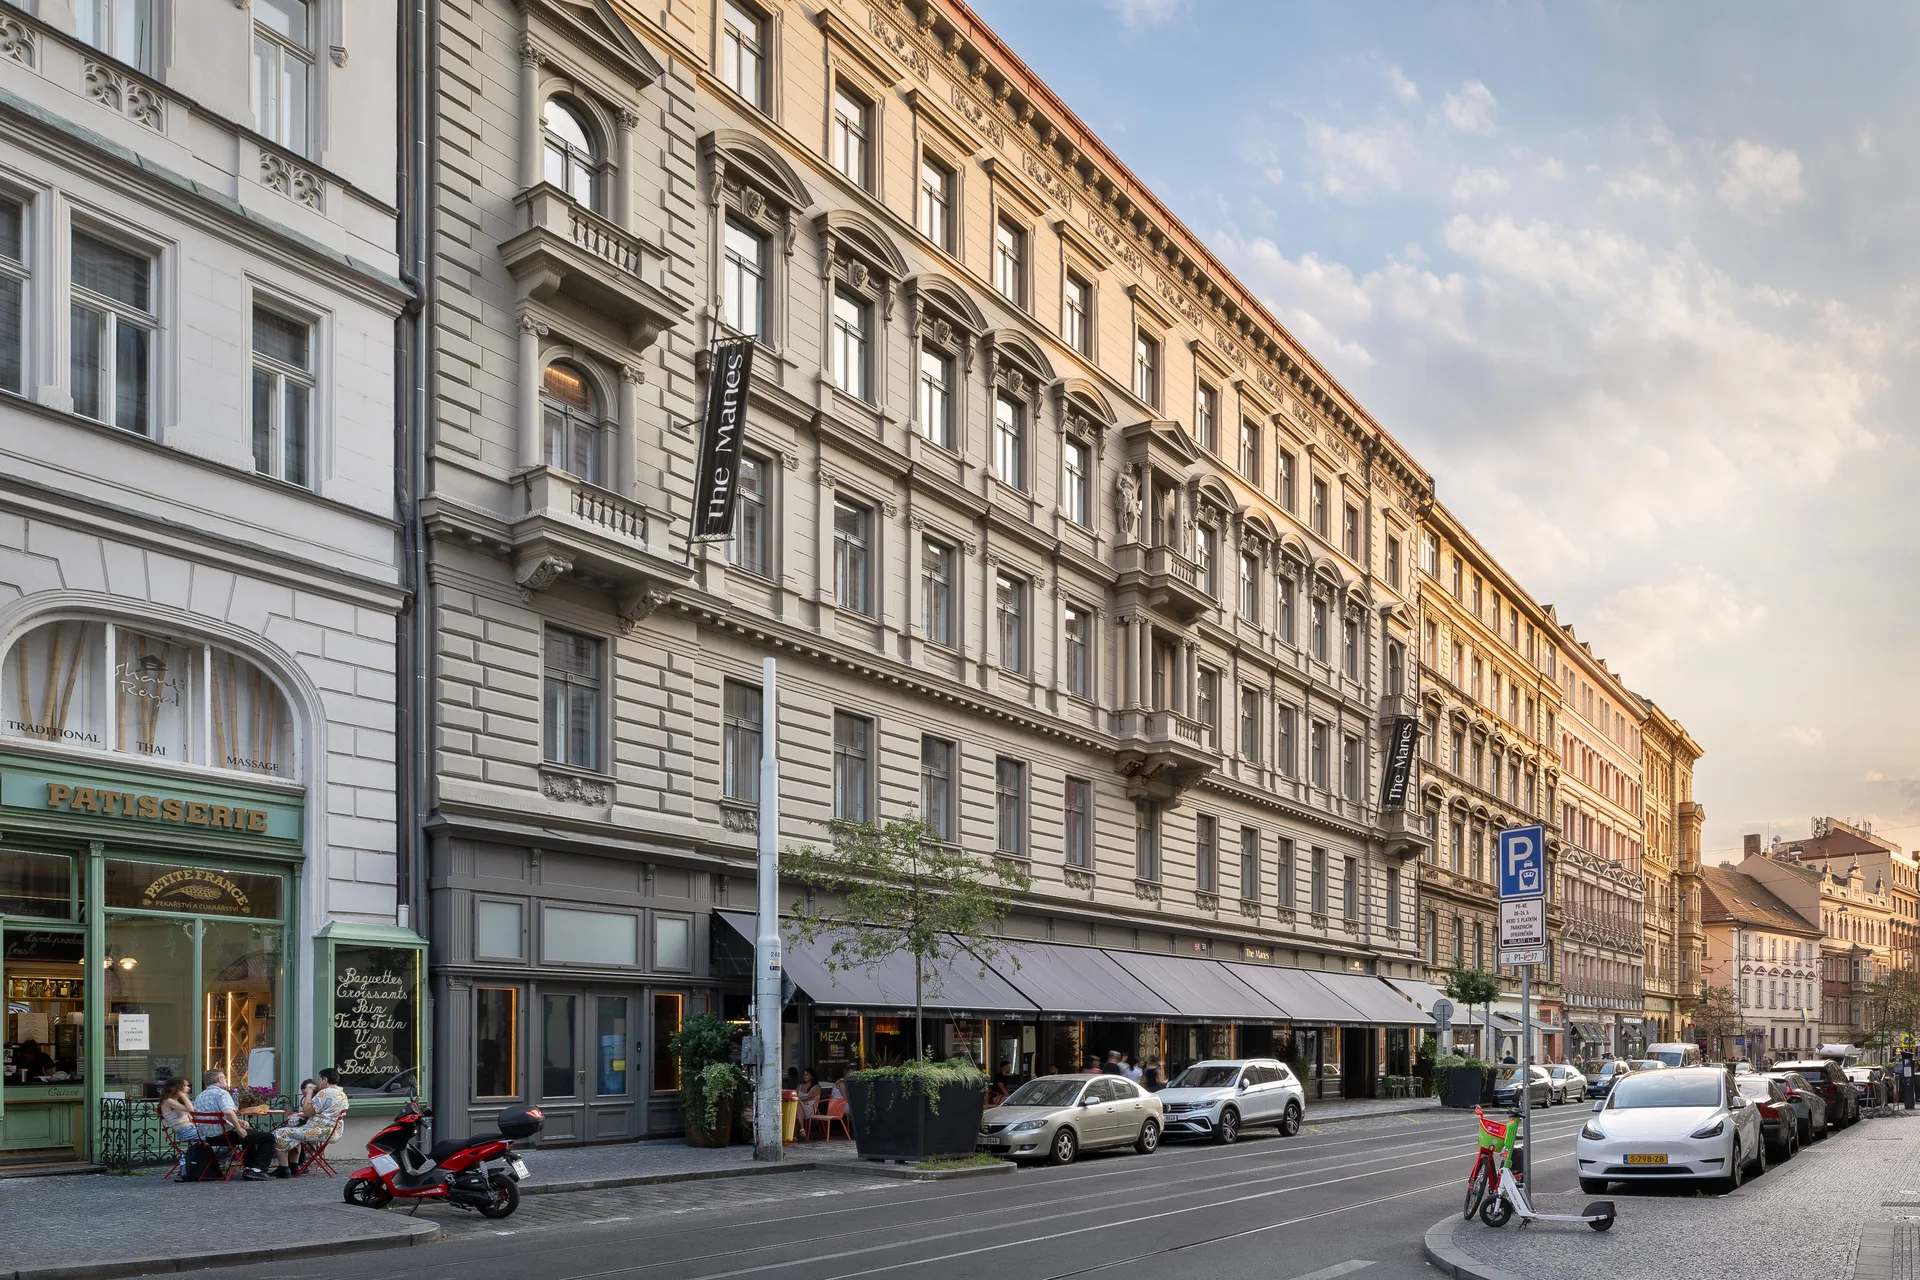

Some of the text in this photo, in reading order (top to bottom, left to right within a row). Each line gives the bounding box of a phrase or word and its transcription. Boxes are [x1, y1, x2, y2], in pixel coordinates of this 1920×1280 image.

[707, 353, 743, 525] The Manes
[7, 720, 101, 743] TRADITIONAL
[136, 741, 166, 756] THAI
[226, 755, 280, 772] MASSAGE
[1388, 722, 1413, 801] The Manes
[47, 782, 269, 832] PATISSERIE
[1508, 836, 1534, 876] P
[144, 870, 249, 906] PETITE FRANCE
[155, 900, 193, 909] PEKAŘSTVÍ
[338, 967, 403, 990] Baguettes
[336, 983, 408, 1000] Croissants
[352, 998, 387, 1014] Pain
[334, 1013, 407, 1029] Tarte Tatin
[354, 1029, 387, 1044] Vins
[820, 1032, 848, 1042] MEZA
[952, 1032, 973, 1041] CRUZ
[354, 1043, 388, 1066] Café
[337, 1059, 401, 1075] Boissons
[48, 1087, 80, 1097] Caisse
